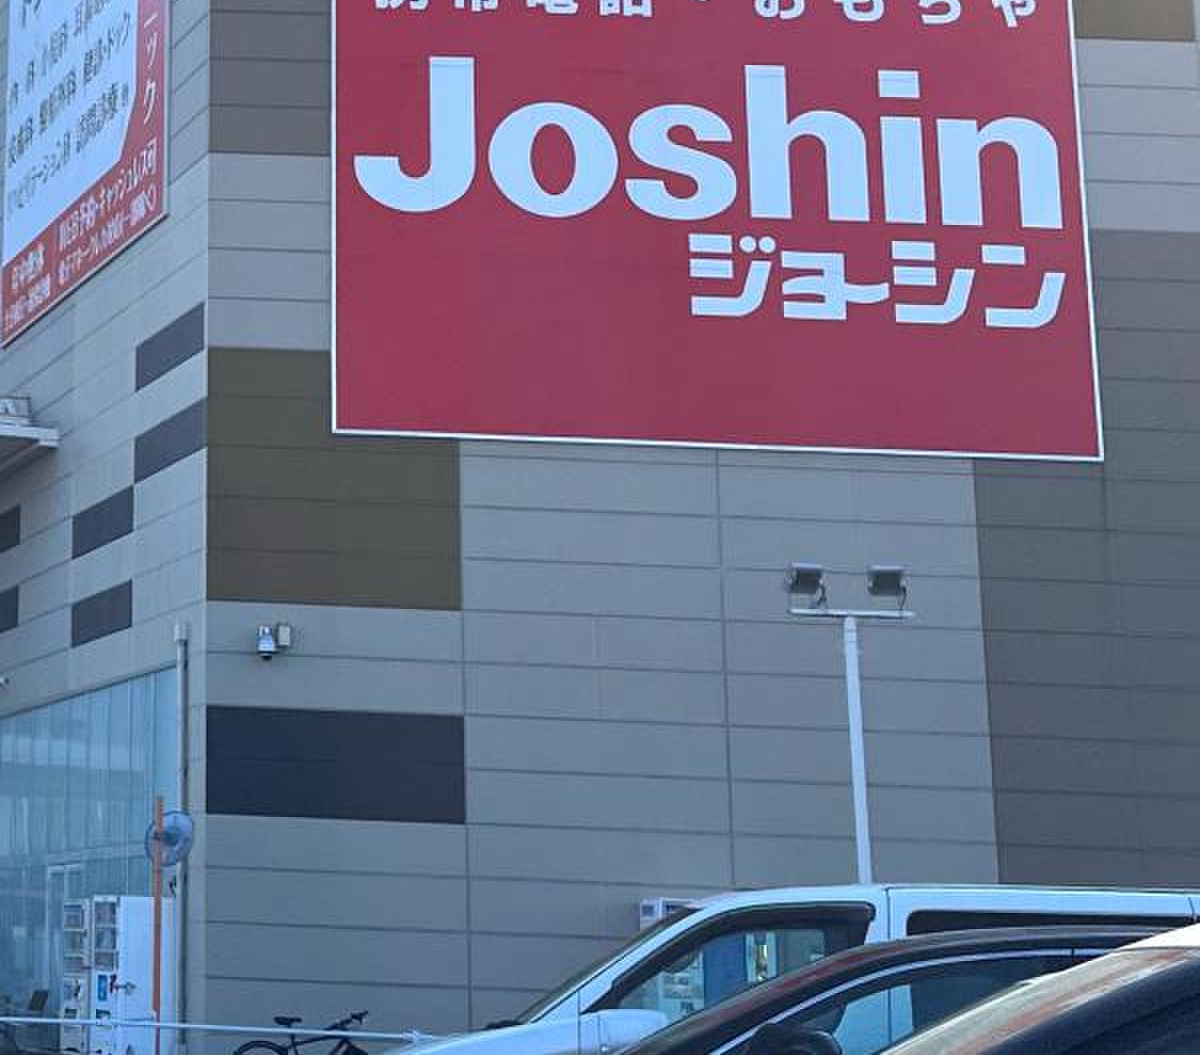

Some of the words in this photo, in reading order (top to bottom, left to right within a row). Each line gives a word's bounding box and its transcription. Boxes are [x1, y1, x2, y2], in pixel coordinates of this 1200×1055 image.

[353, 55, 1063, 230] Joshin
[688, 232, 1067, 329] ジョーシン
